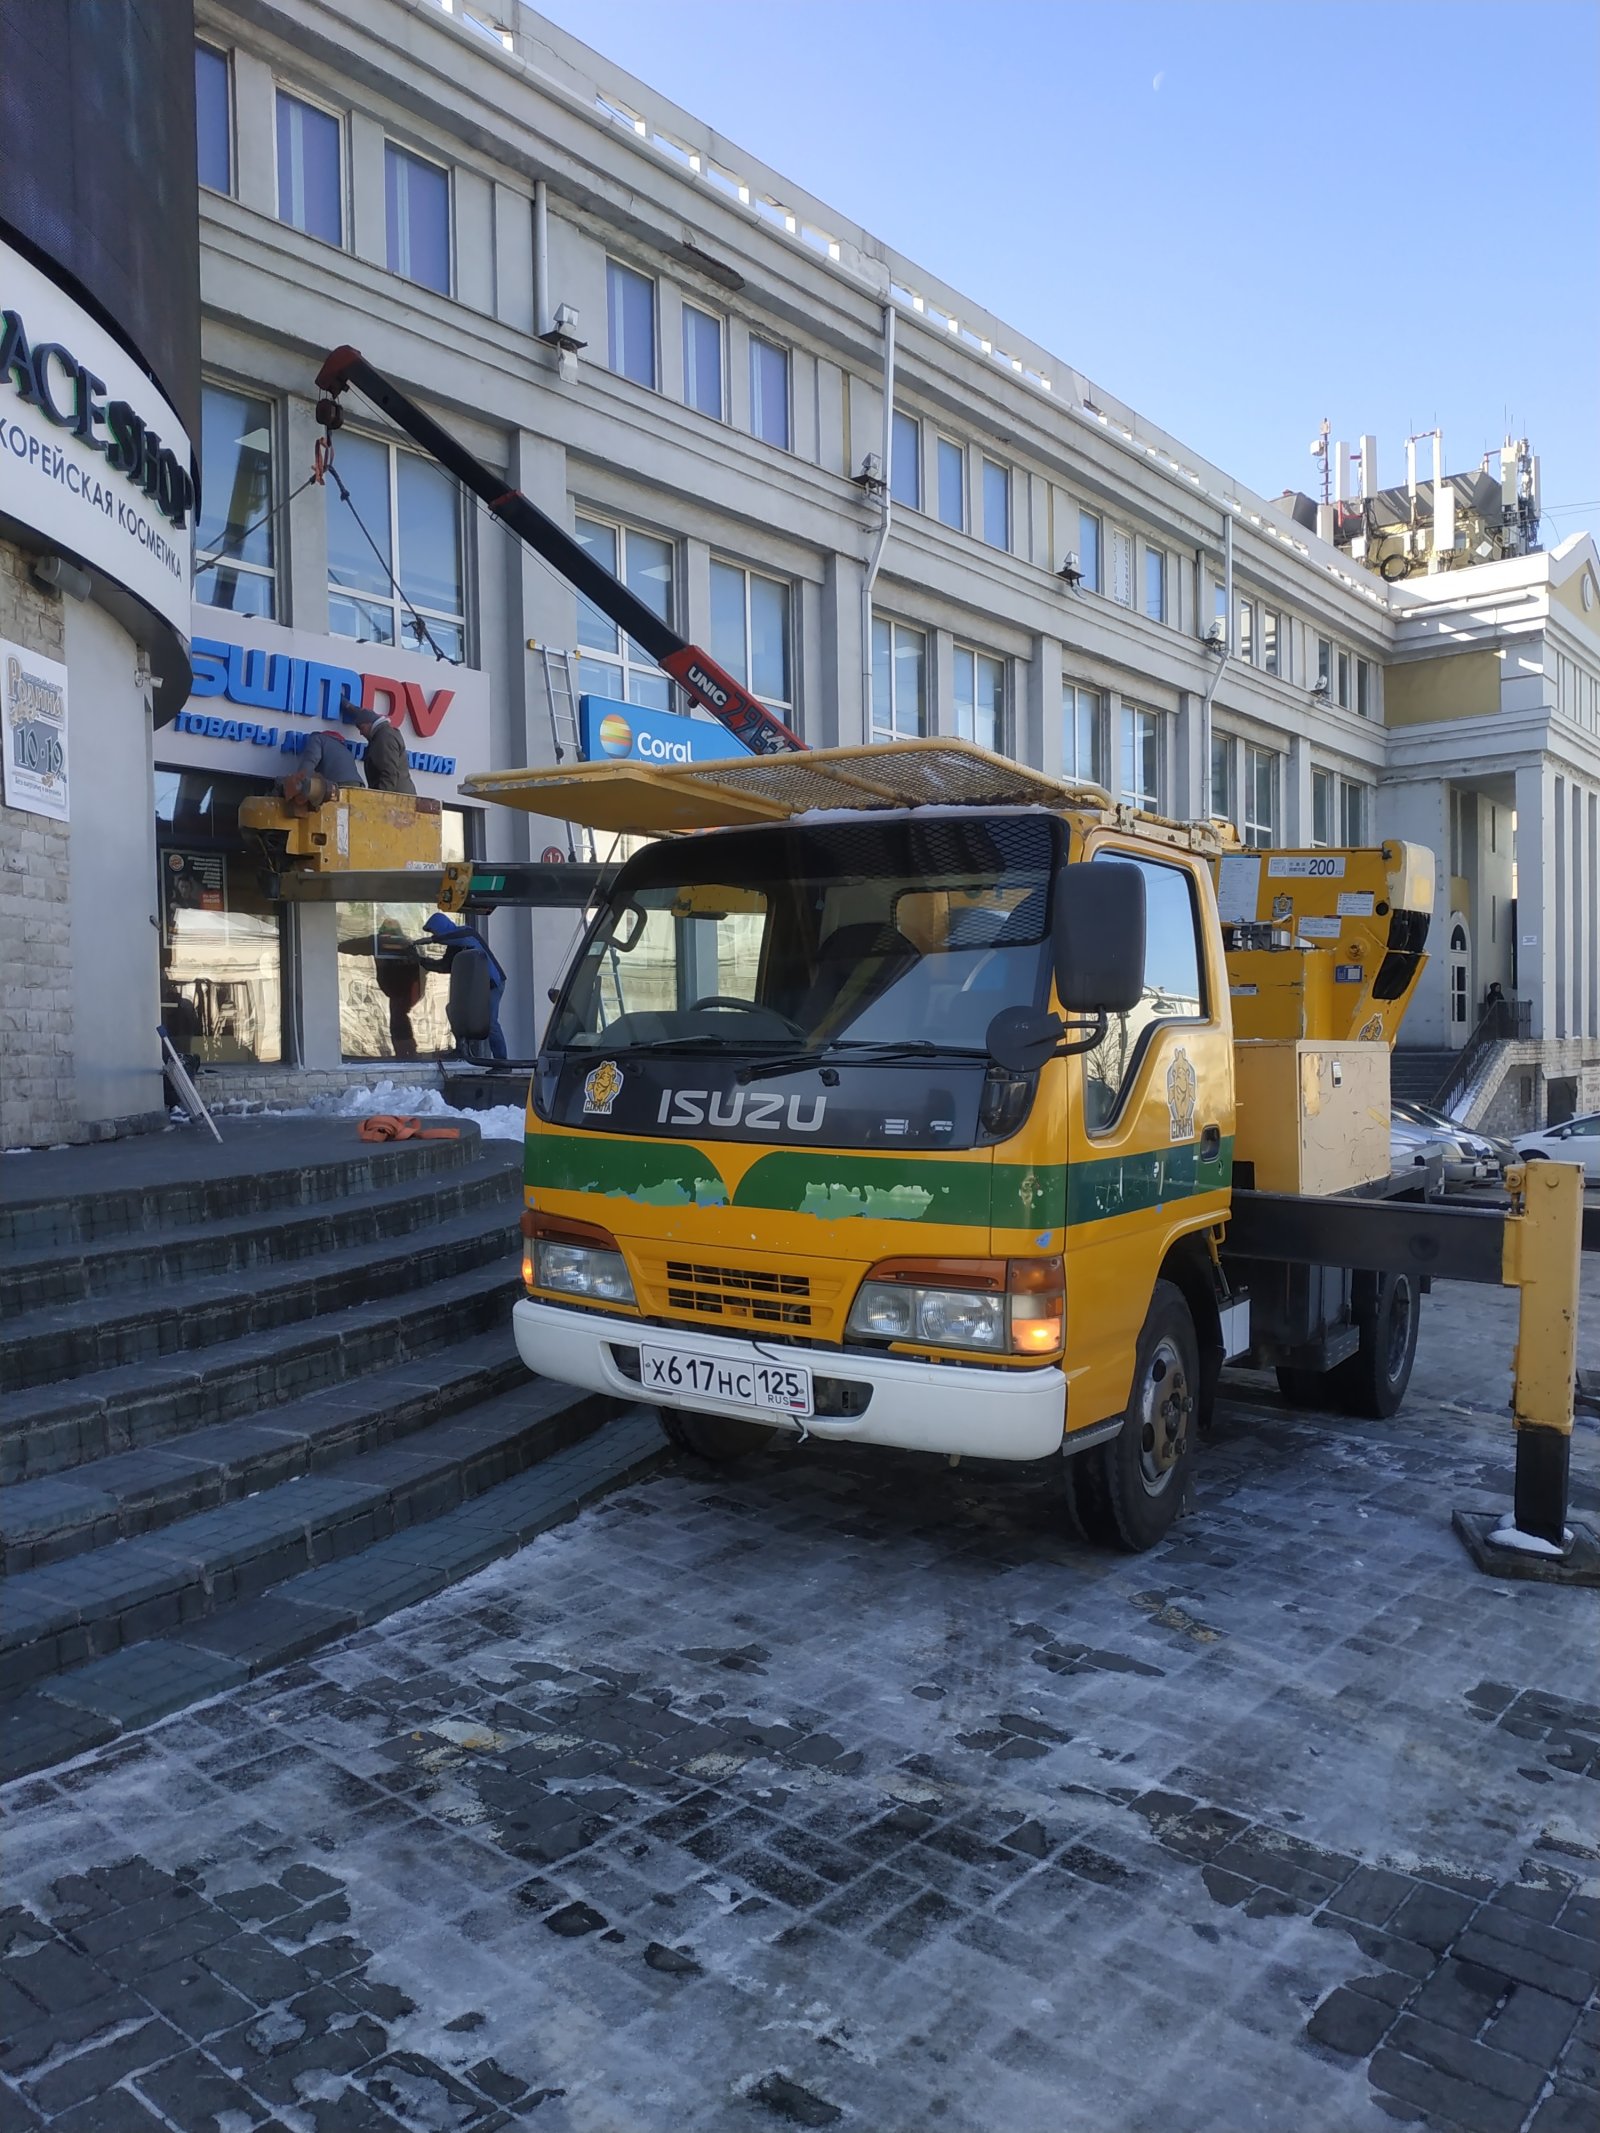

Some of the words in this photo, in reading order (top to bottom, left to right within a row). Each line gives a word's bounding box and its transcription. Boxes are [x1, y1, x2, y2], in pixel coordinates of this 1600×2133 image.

[118, 499, 182, 582] КОСМЕТИКА
[687, 665, 728, 707] UNIC
[174, 711, 278, 747] ТОВАРЫ
[637, 732, 694, 763] Coral
[1309, 859, 1335, 875] 200
[657, 1089, 827, 1132] ISUZU
[758, 1370, 799, 1397] 125
[767, 1395, 789, 1405] RUS
